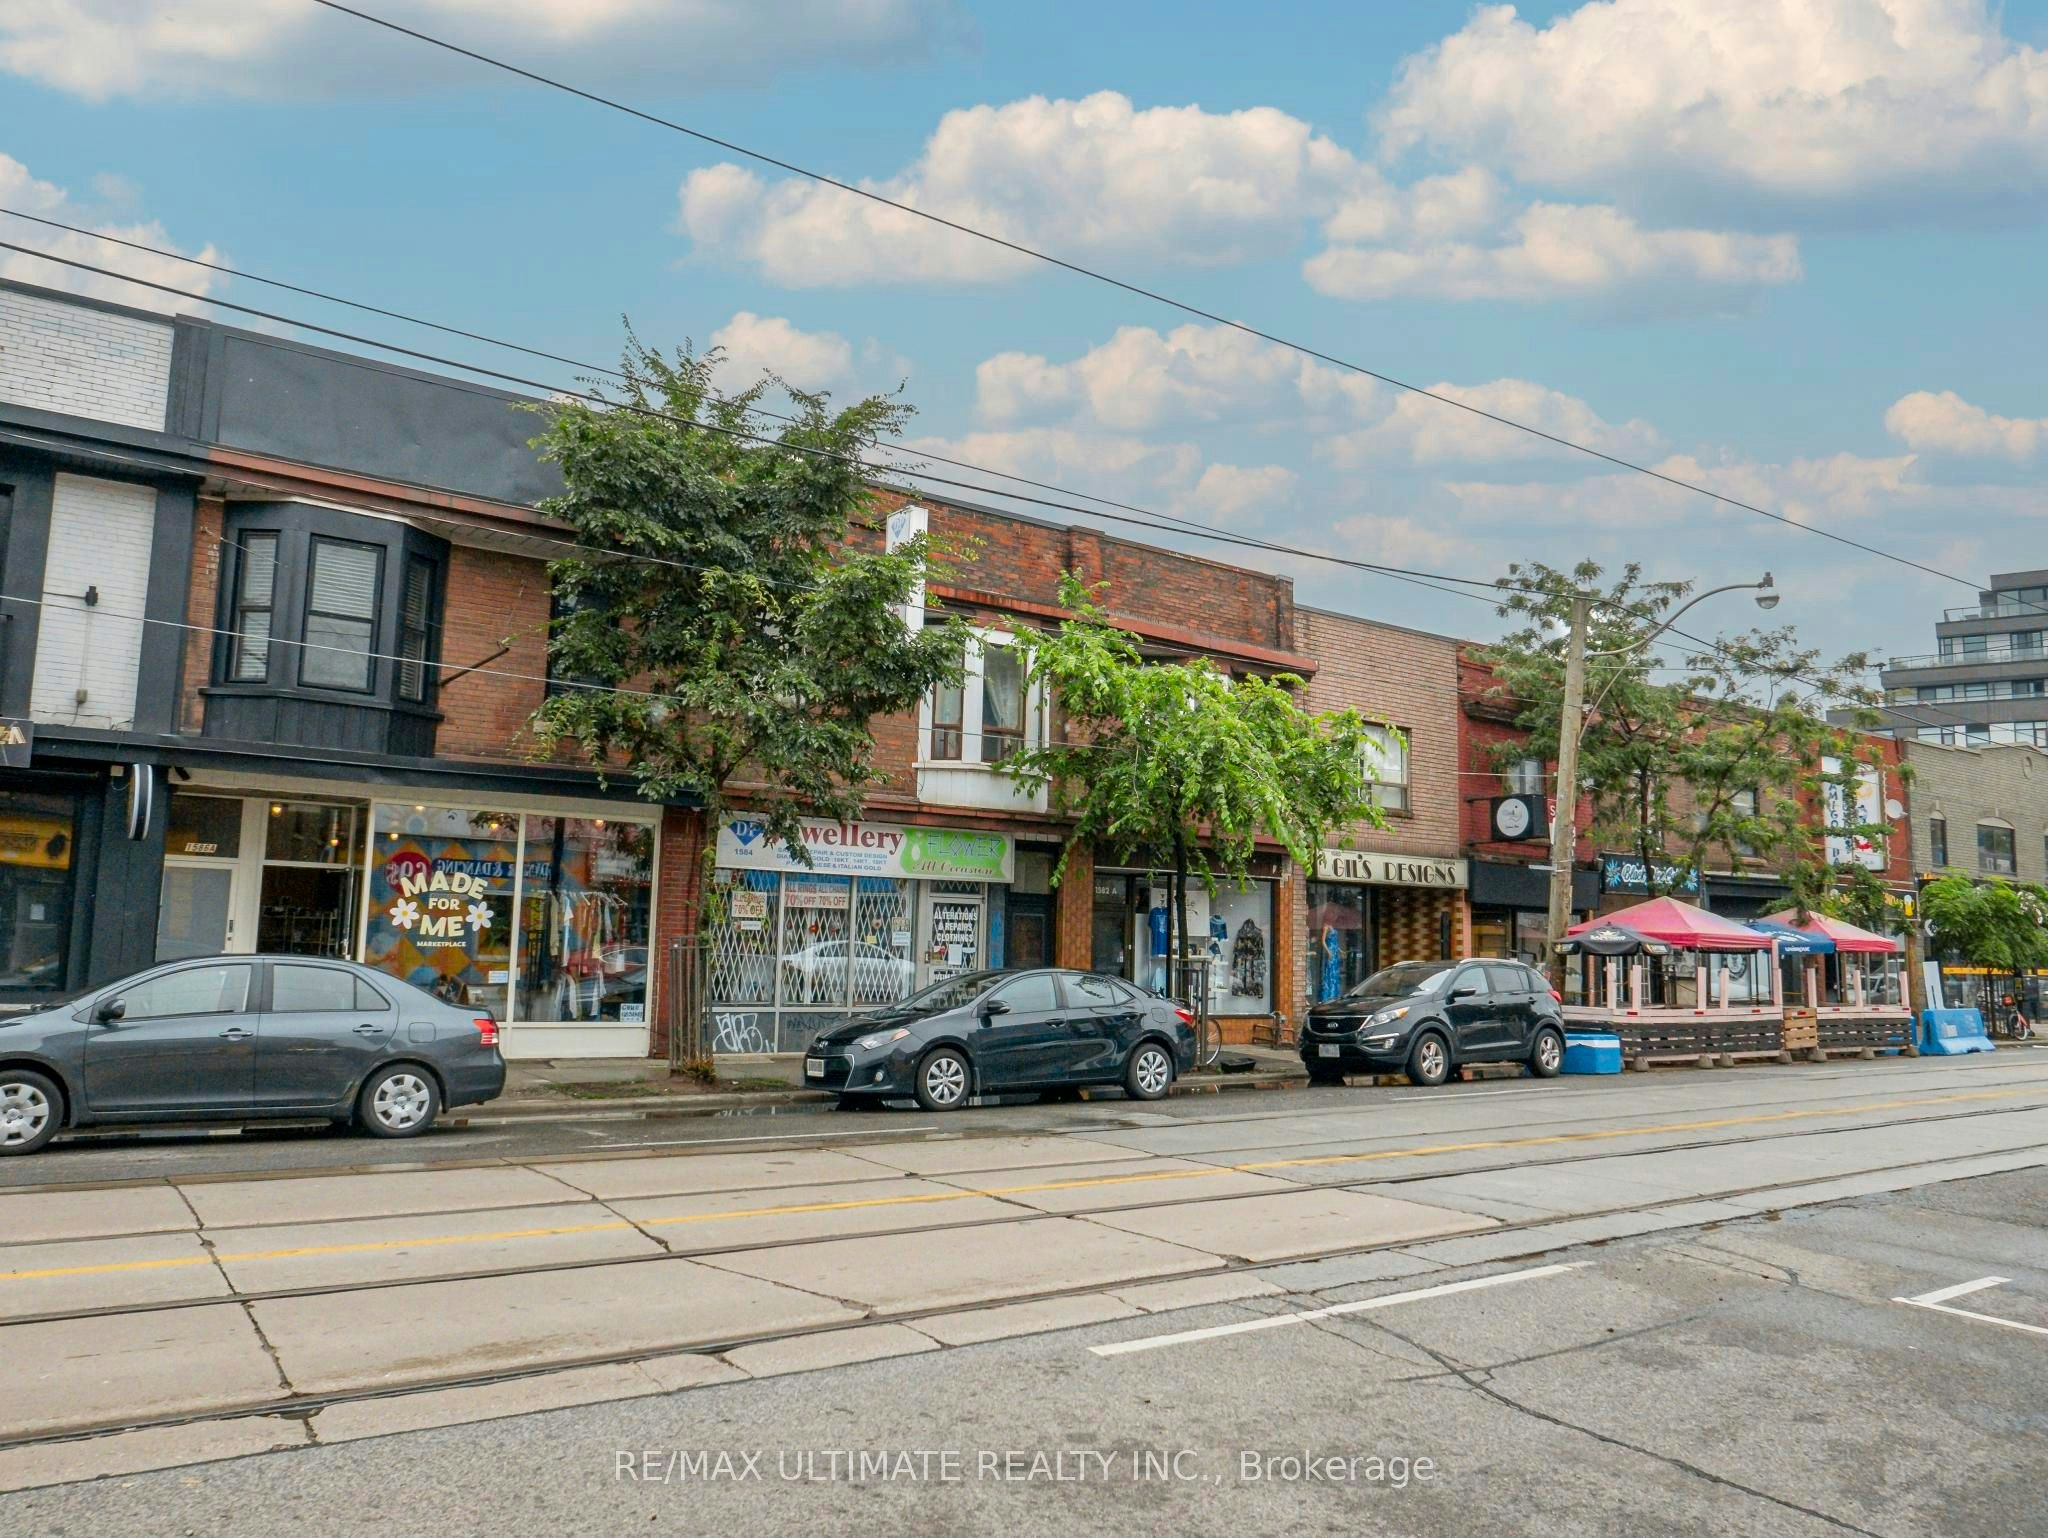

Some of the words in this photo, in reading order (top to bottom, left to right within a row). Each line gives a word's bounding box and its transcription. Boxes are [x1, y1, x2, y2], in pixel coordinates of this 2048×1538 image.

[768, 823, 905, 855] wellery
[928, 832, 1001, 857] FLOWER
[735, 848, 753, 856] 1584
[1333, 854, 1372, 880] GIL'S
[1384, 861, 1456, 885] DESIGNS
[400, 870, 488, 900] MADE
[428, 897, 460, 911] FOR
[804, 896, 817, 905] OFF
[833, 897, 847, 906] OFF
[934, 911, 978, 921] ALTERATIONS
[419, 914, 465, 938] ME
[945, 922, 973, 932] REPAIRS
[416, 940, 466, 948] MARKETPLACE
